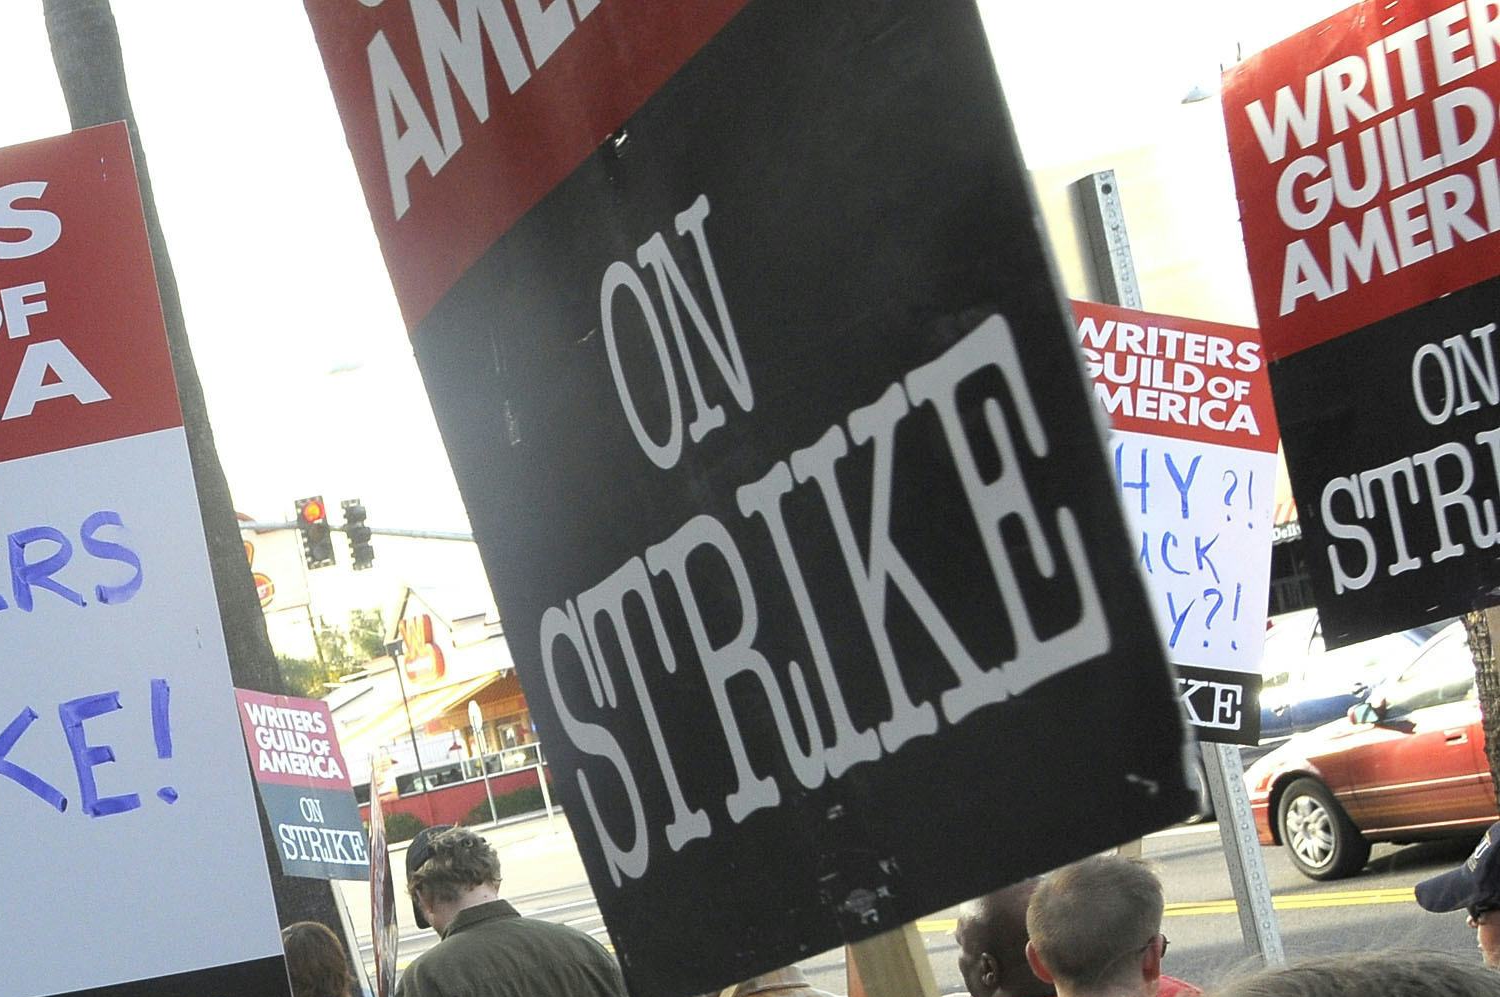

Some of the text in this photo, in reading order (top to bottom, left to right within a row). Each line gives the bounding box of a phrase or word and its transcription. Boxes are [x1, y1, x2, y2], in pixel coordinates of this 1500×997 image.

[1245, 0, 1500, 164] WRITER
[1276, 86, 1495, 231] GUILD
[1279, 158, 1500, 317] AMERI
[601, 194, 754, 469] ON
[1078, 317, 1261, 373] WRITERS
[1207, 376, 1250, 401] OF
[1412, 323, 1500, 425] ON
[1094, 382, 1261, 436] MERICA
[540, 313, 1110, 887] STRIKE
[1165, 582, 1243, 650] Y?!
[244, 702, 327, 735] WRITERS
[1174, 679, 1243, 731] KE
[255, 727, 331, 757] GUILD OF
[259, 749, 344, 780] AMERICA
[299, 797, 324, 824] ON
[278, 824, 370, 866] STRIKE
